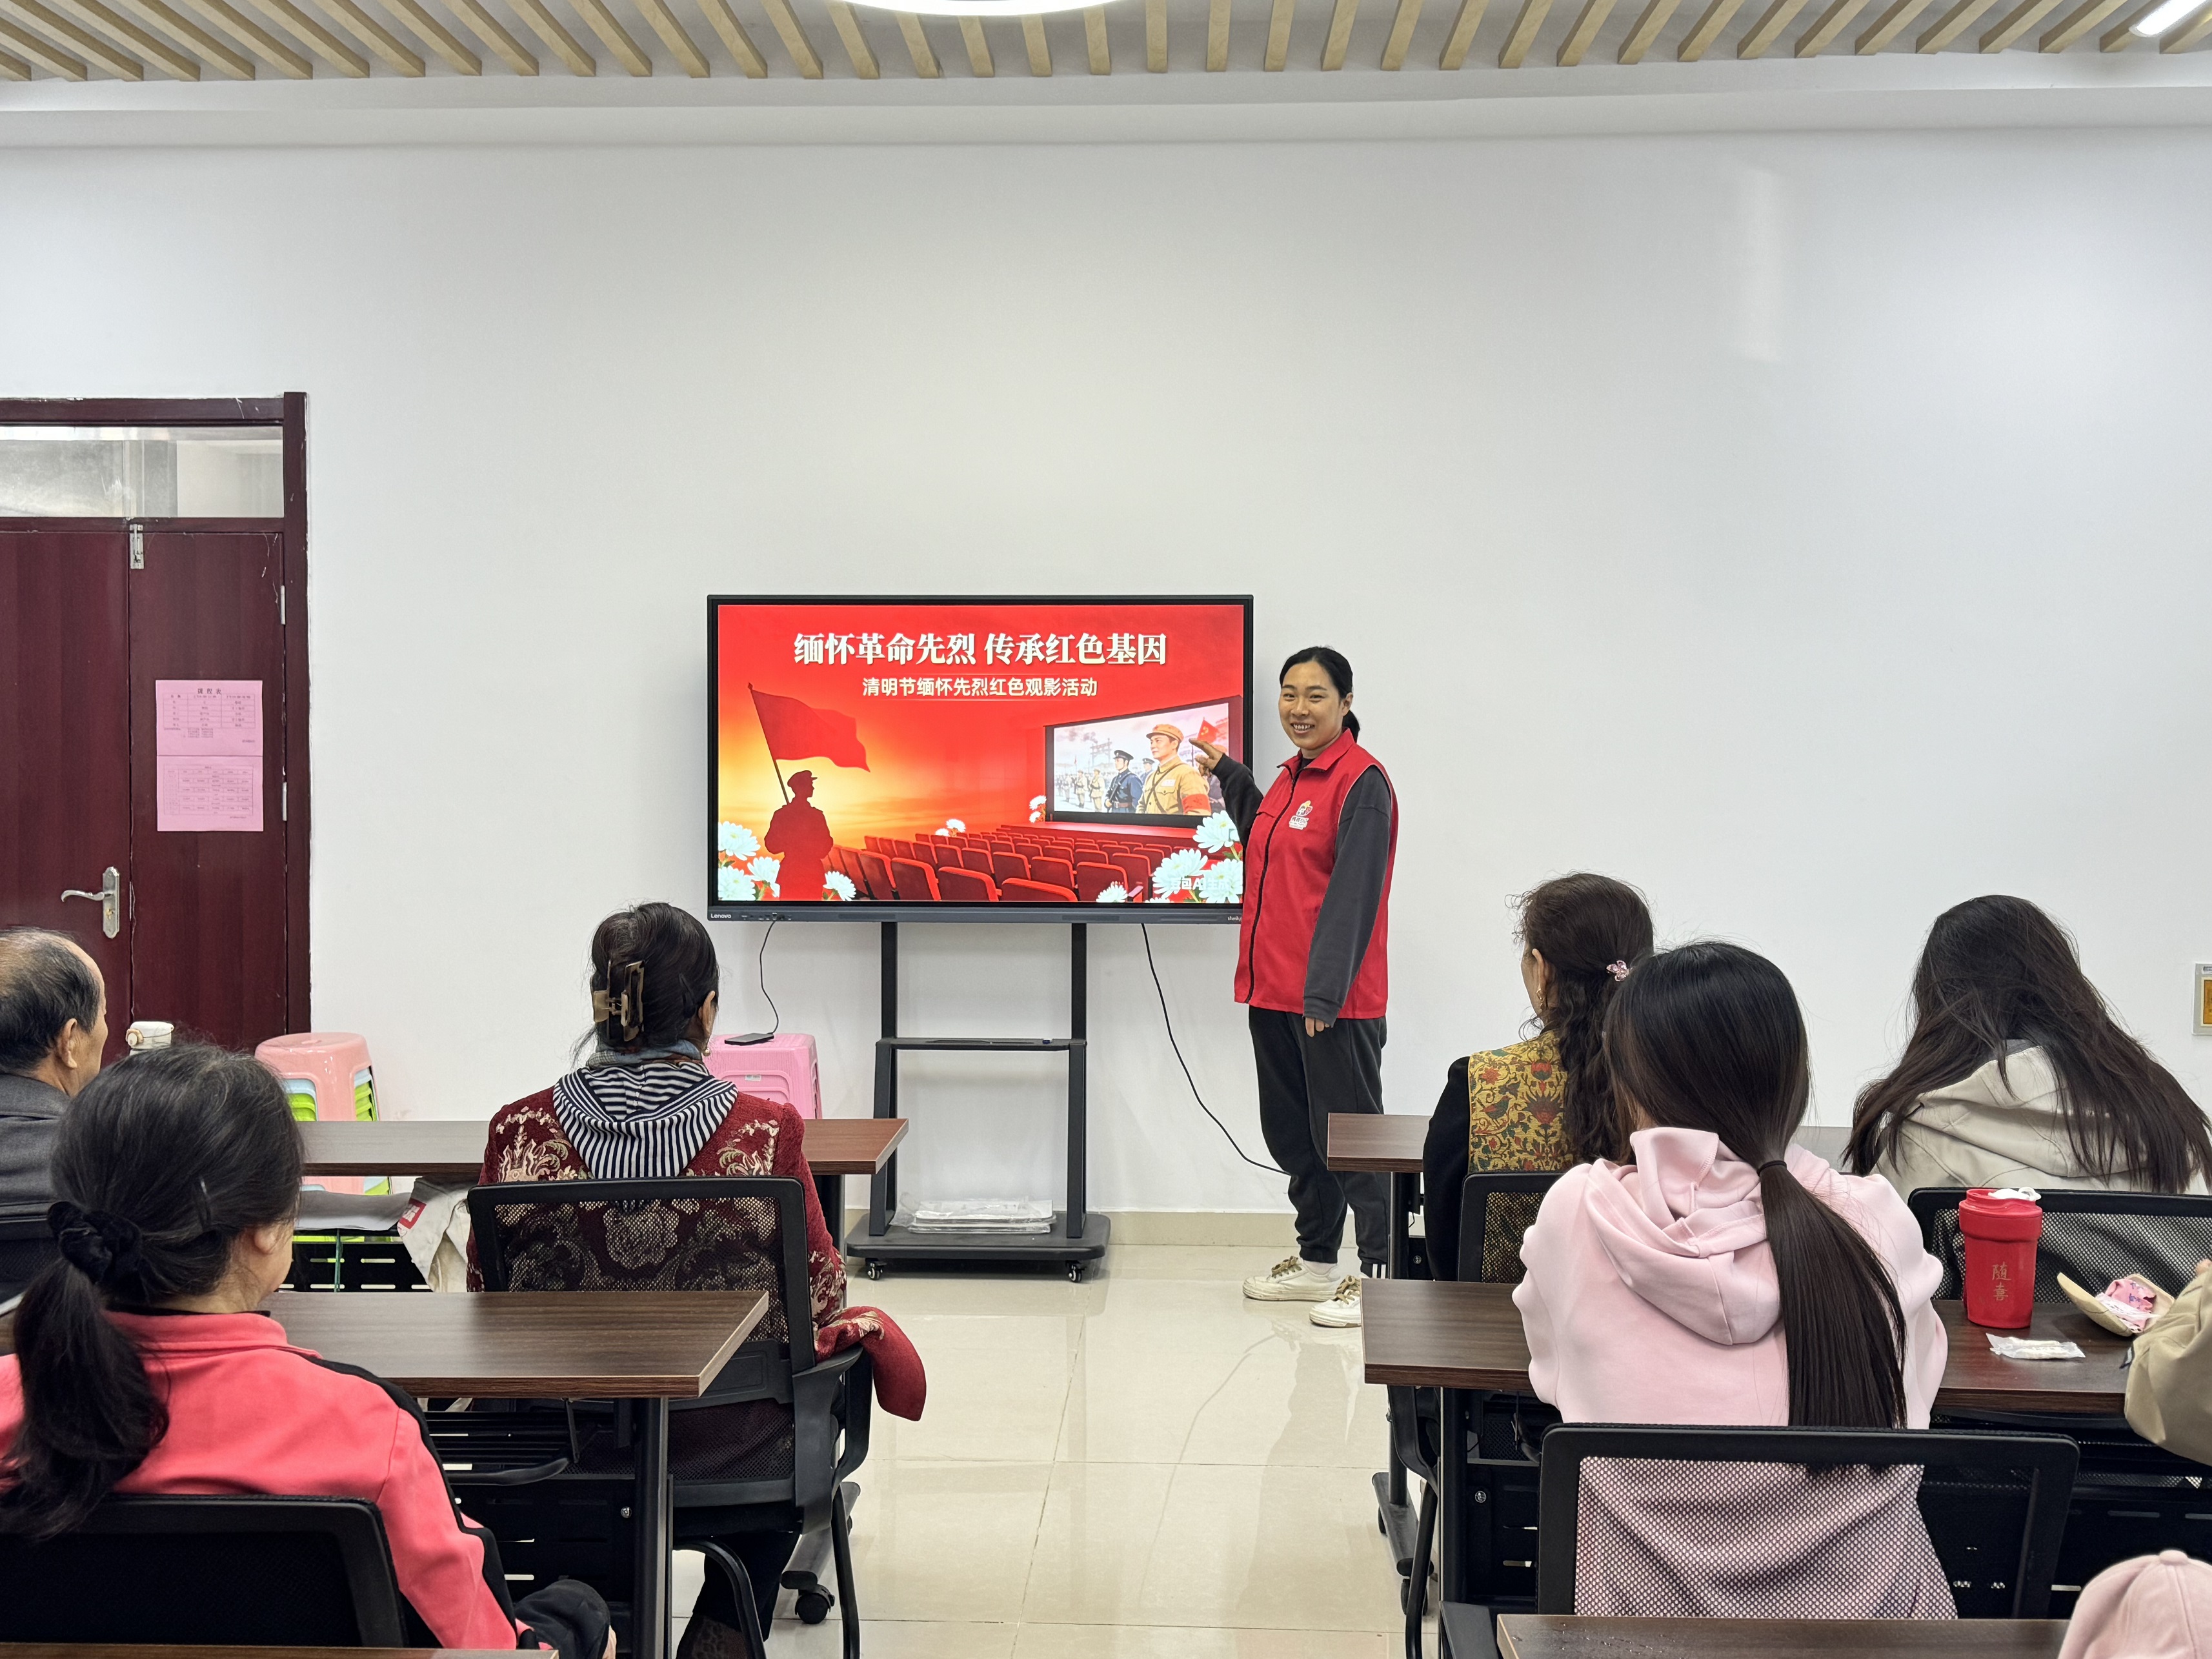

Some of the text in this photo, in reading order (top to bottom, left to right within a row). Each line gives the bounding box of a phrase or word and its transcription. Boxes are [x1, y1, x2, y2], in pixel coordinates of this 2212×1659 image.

[794, 632, 1167, 665] 缅怀革命先烈 传承红色基因
[862, 677, 1098, 696] 清明节缅怀先烈红色观影活动
